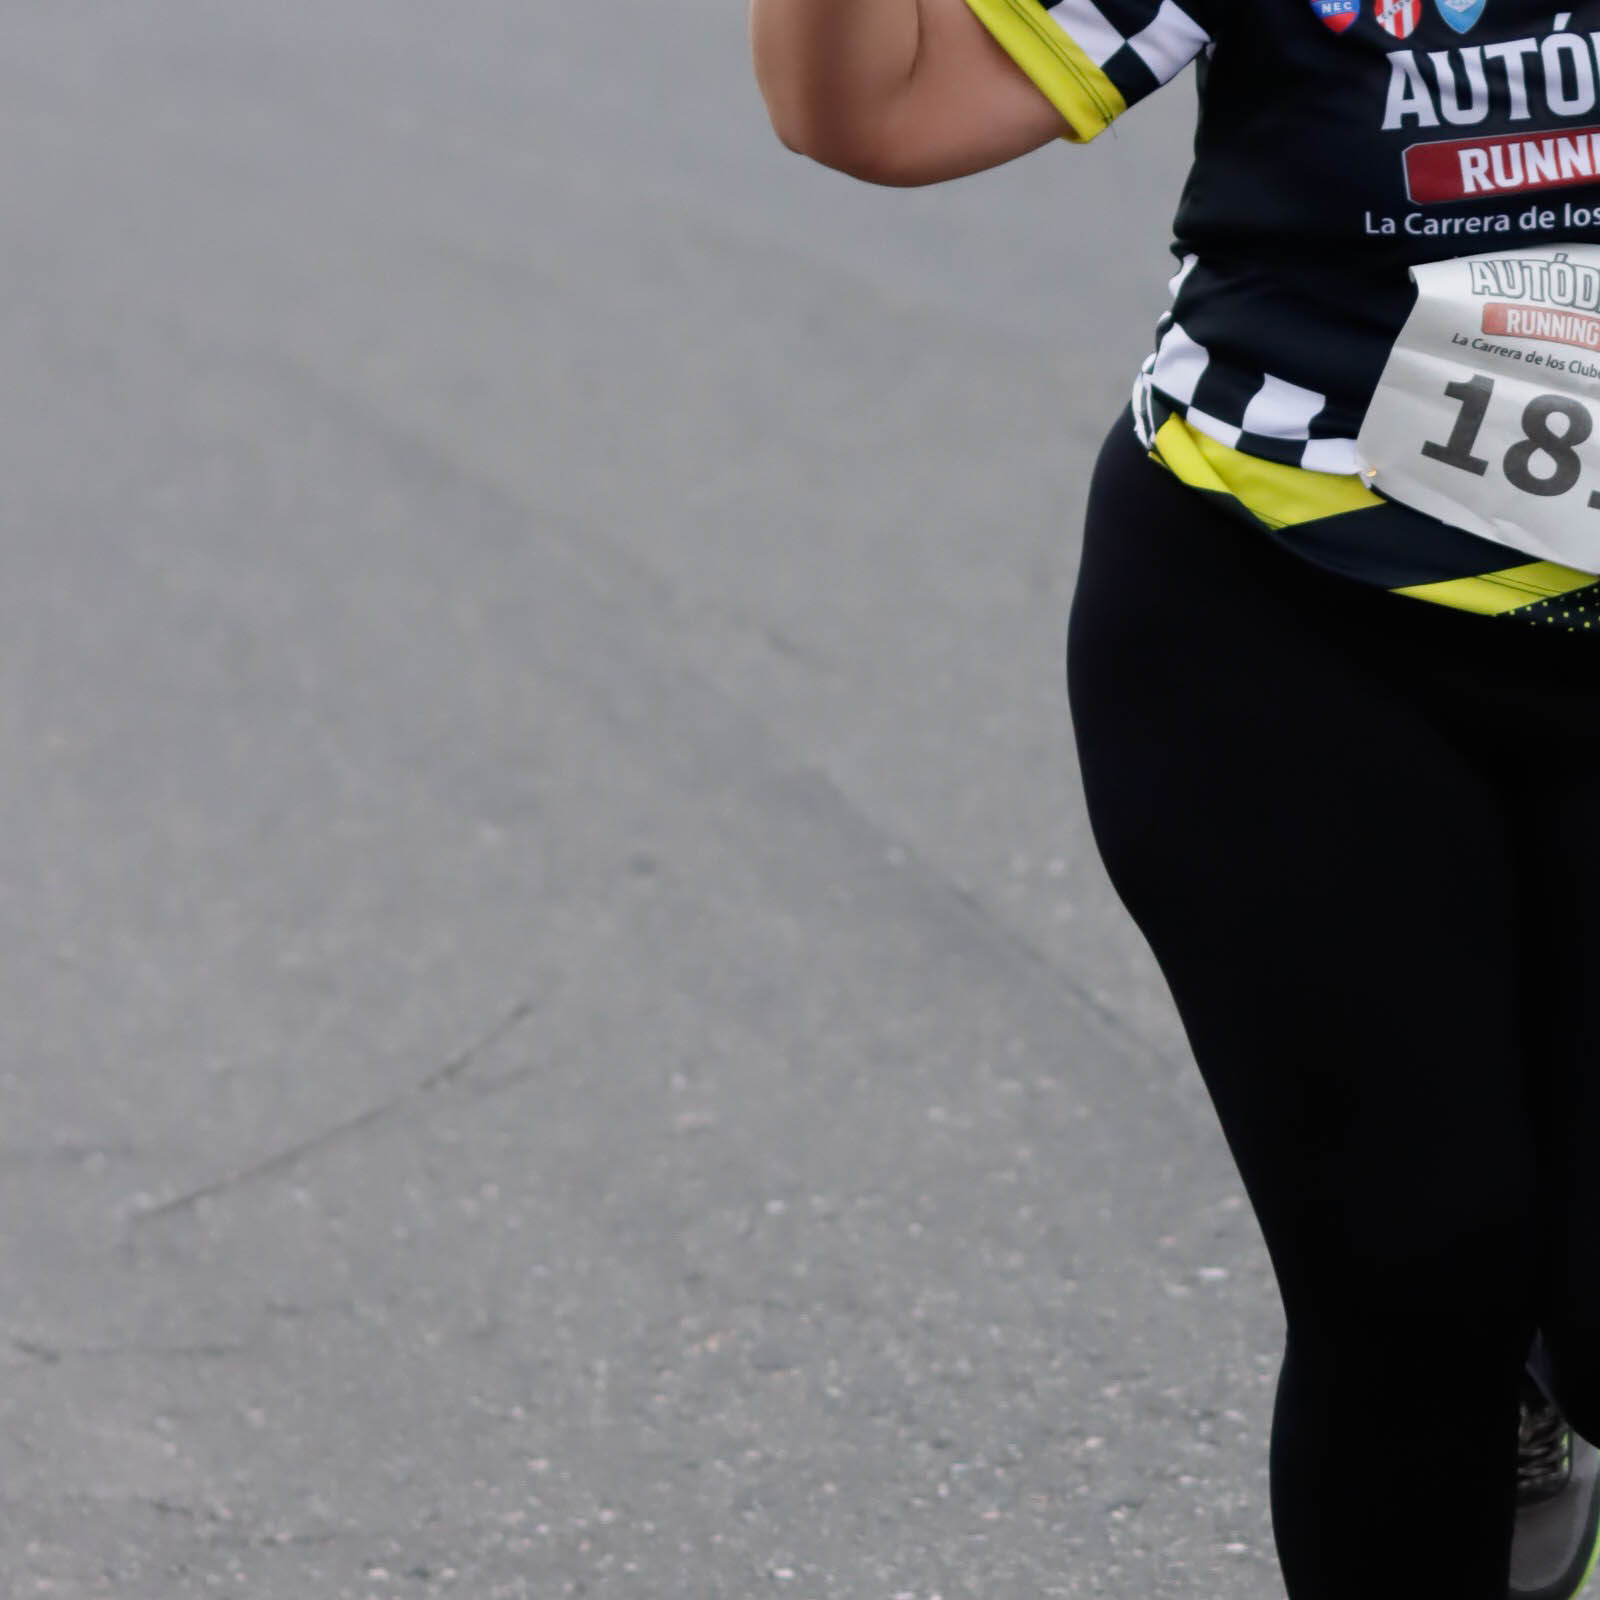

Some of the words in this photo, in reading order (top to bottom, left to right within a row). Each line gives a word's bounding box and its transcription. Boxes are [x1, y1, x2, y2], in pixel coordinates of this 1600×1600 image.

[1321, 1, 1353, 14] NEC
[1364, 211, 1396, 235] La
[1404, 213, 1510, 235] Carrera
[1519, 205, 1555, 229] de
[1505, 308, 1600, 348] RUNNING
[1451, 332, 1469, 347] La
[1471, 335, 1522, 361] Carrera
[1525, 349, 1543, 367] de
[1546, 353, 1565, 372] los
